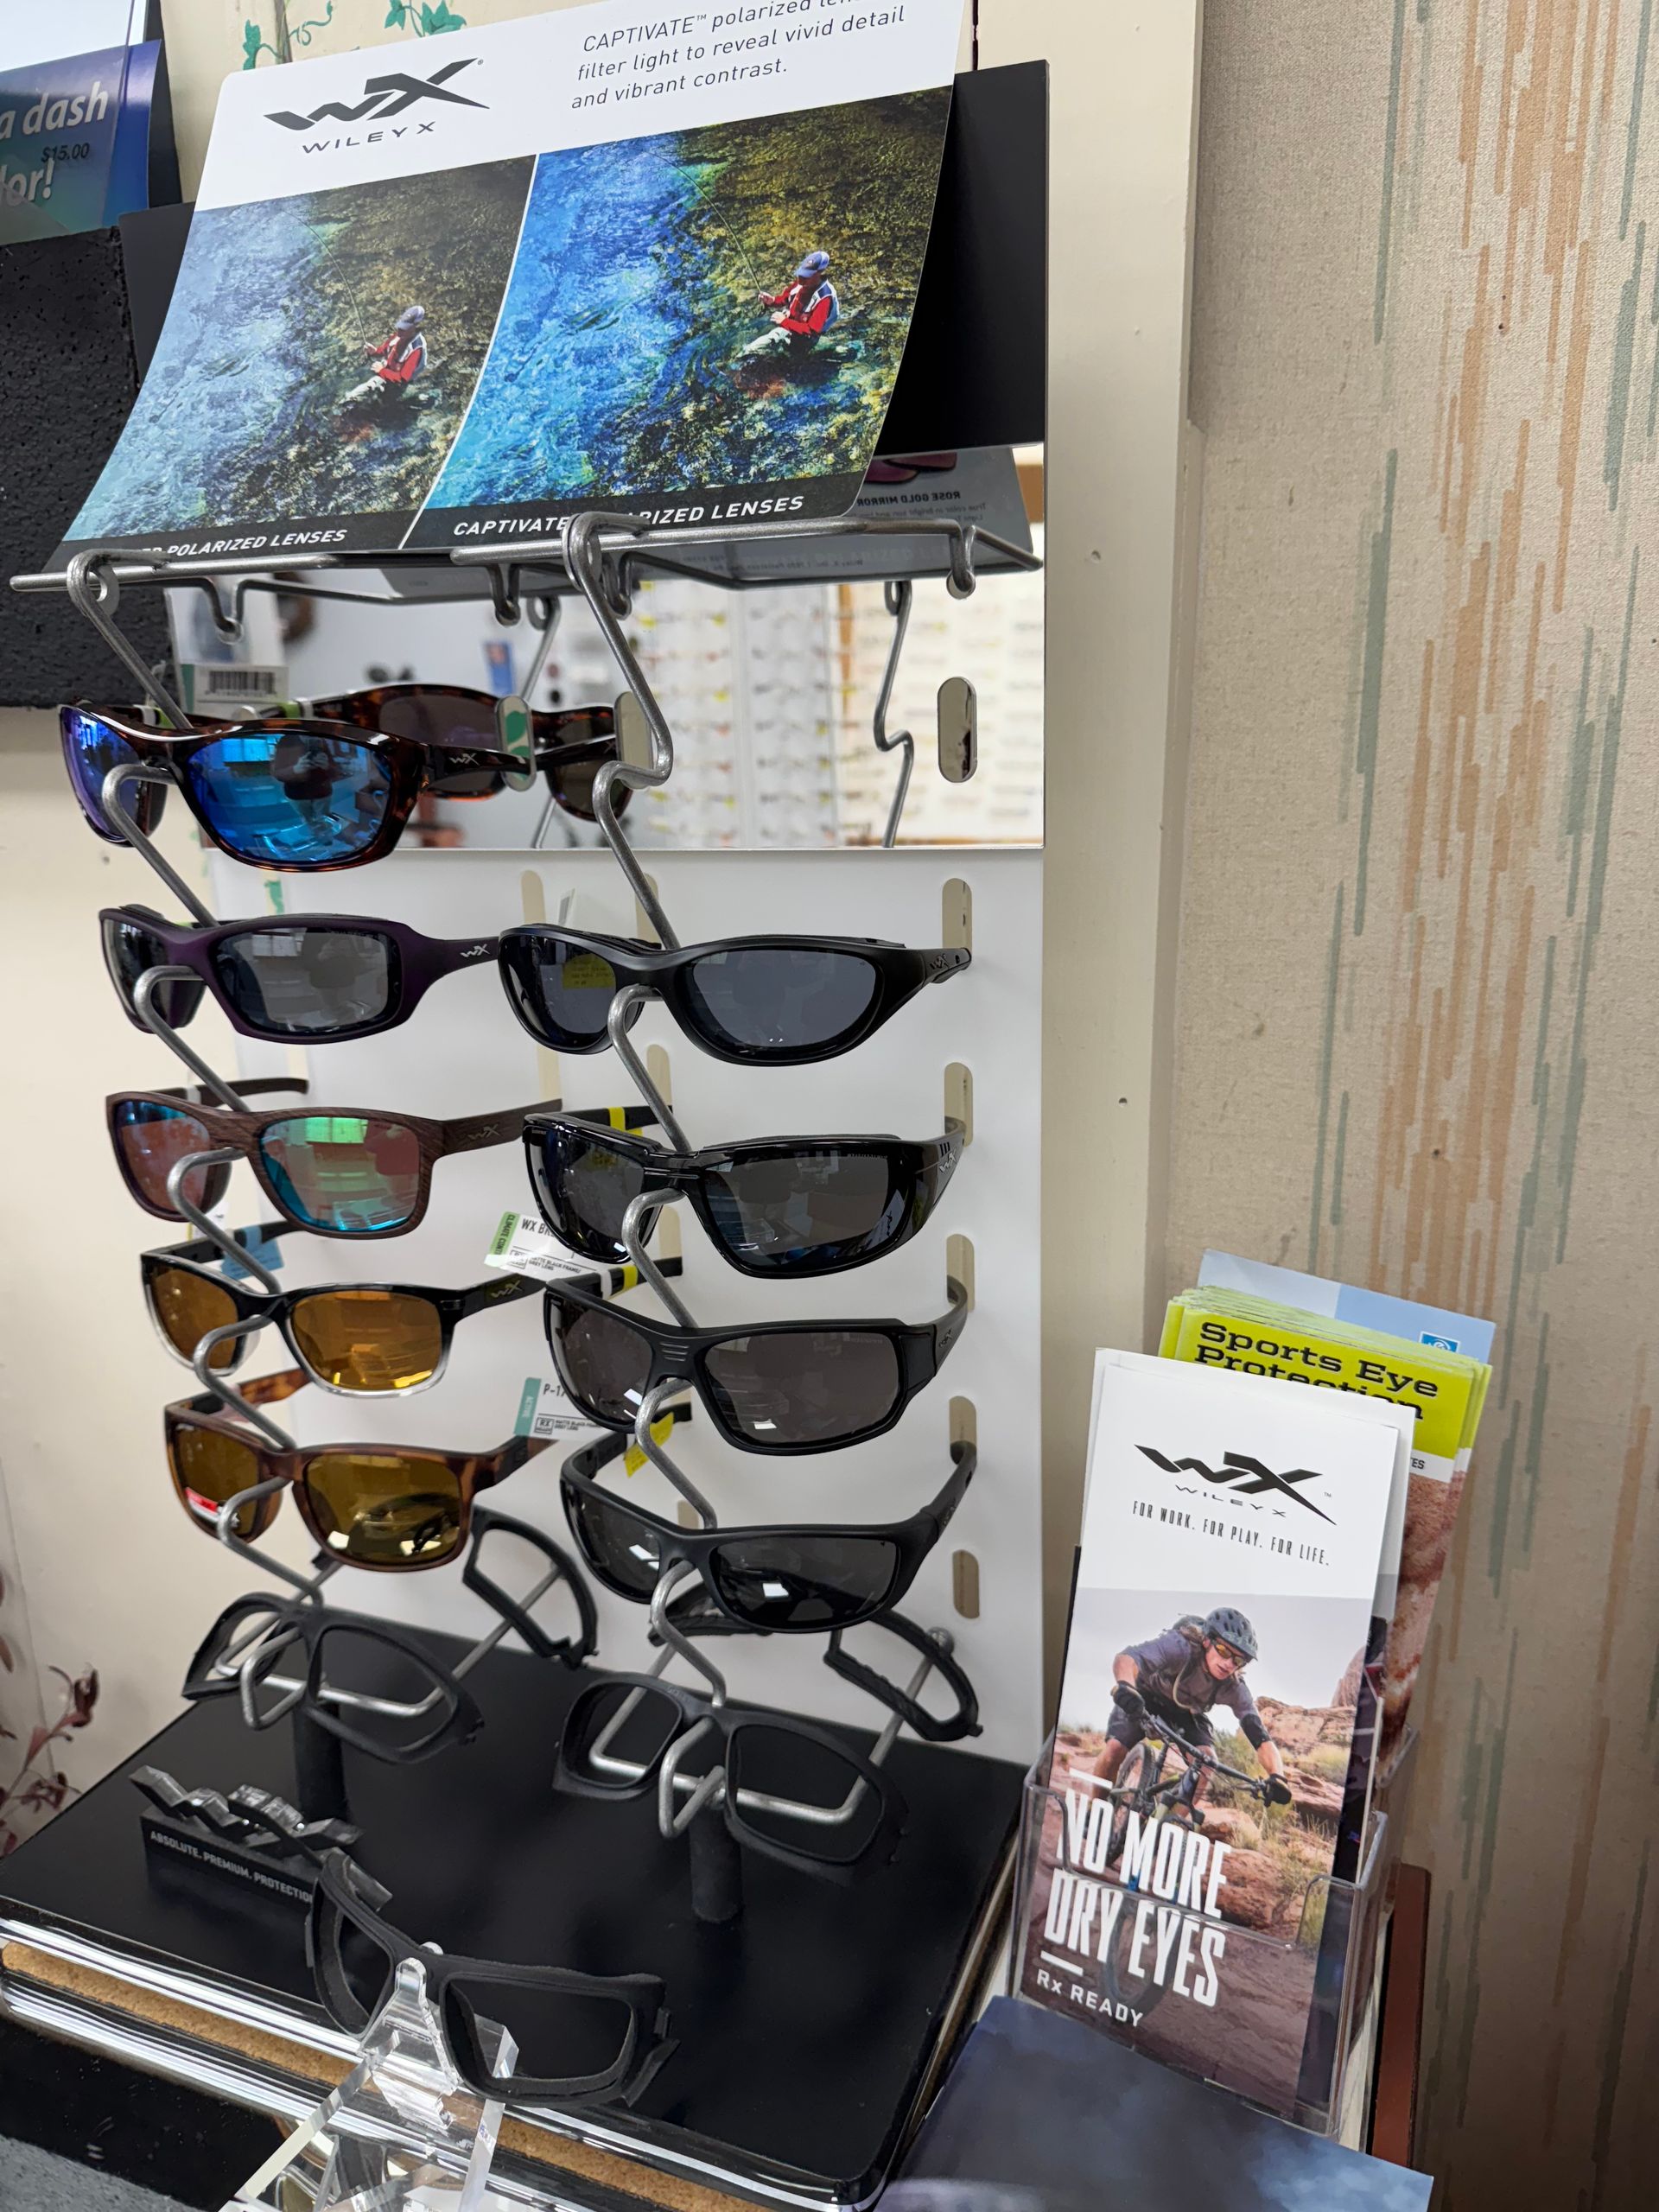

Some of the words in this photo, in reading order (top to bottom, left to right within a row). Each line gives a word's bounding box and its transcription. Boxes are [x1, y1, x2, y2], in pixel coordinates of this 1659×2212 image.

[711, 0, 811, 33] polarized
[578, 60, 626, 81] filter
[633, 48, 679, 73] light
[686, 45, 705, 60] to
[713, 29, 778, 57] reveal
[785, 18, 834, 41] vivid
[842, 5, 905, 33] detail
[22, 81, 109, 136] dash
[571, 87, 607, 110] and
[615, 74, 685, 102] vibrant
[693, 57, 787, 88] contrast.
[41, 142, 90, 163] $15.00
[711, 496, 804, 519] LENSES
[270, 529, 347, 548] LENSES
[521, 1217, 537, 1232] WX
[1200, 1320, 1343, 1374] Sports
[1355, 1358, 1439, 1398] Eye
[1133, 1500, 1153, 1519] FOR
[1160, 1507, 1195, 1530] WORK.
[1203, 1518, 1224, 1537] FOR
[1230, 1526, 1262, 1548] PLAY.
[1271, 1536, 1292, 1556] FOR
[1299, 1543, 1330, 1567] LIFE.
[150, 1830, 203, 1859] ABSOLUTE.
[203, 1852, 253, 1881] PREMIUM.
[1056, 1787, 1114, 1874] NO
[1119, 1809, 1232, 1919] MORE
[1044, 1868, 1123, 1964] DRY
[1128, 1899, 1227, 2007] EYES
[1070, 1983, 1144, 2027] READY
